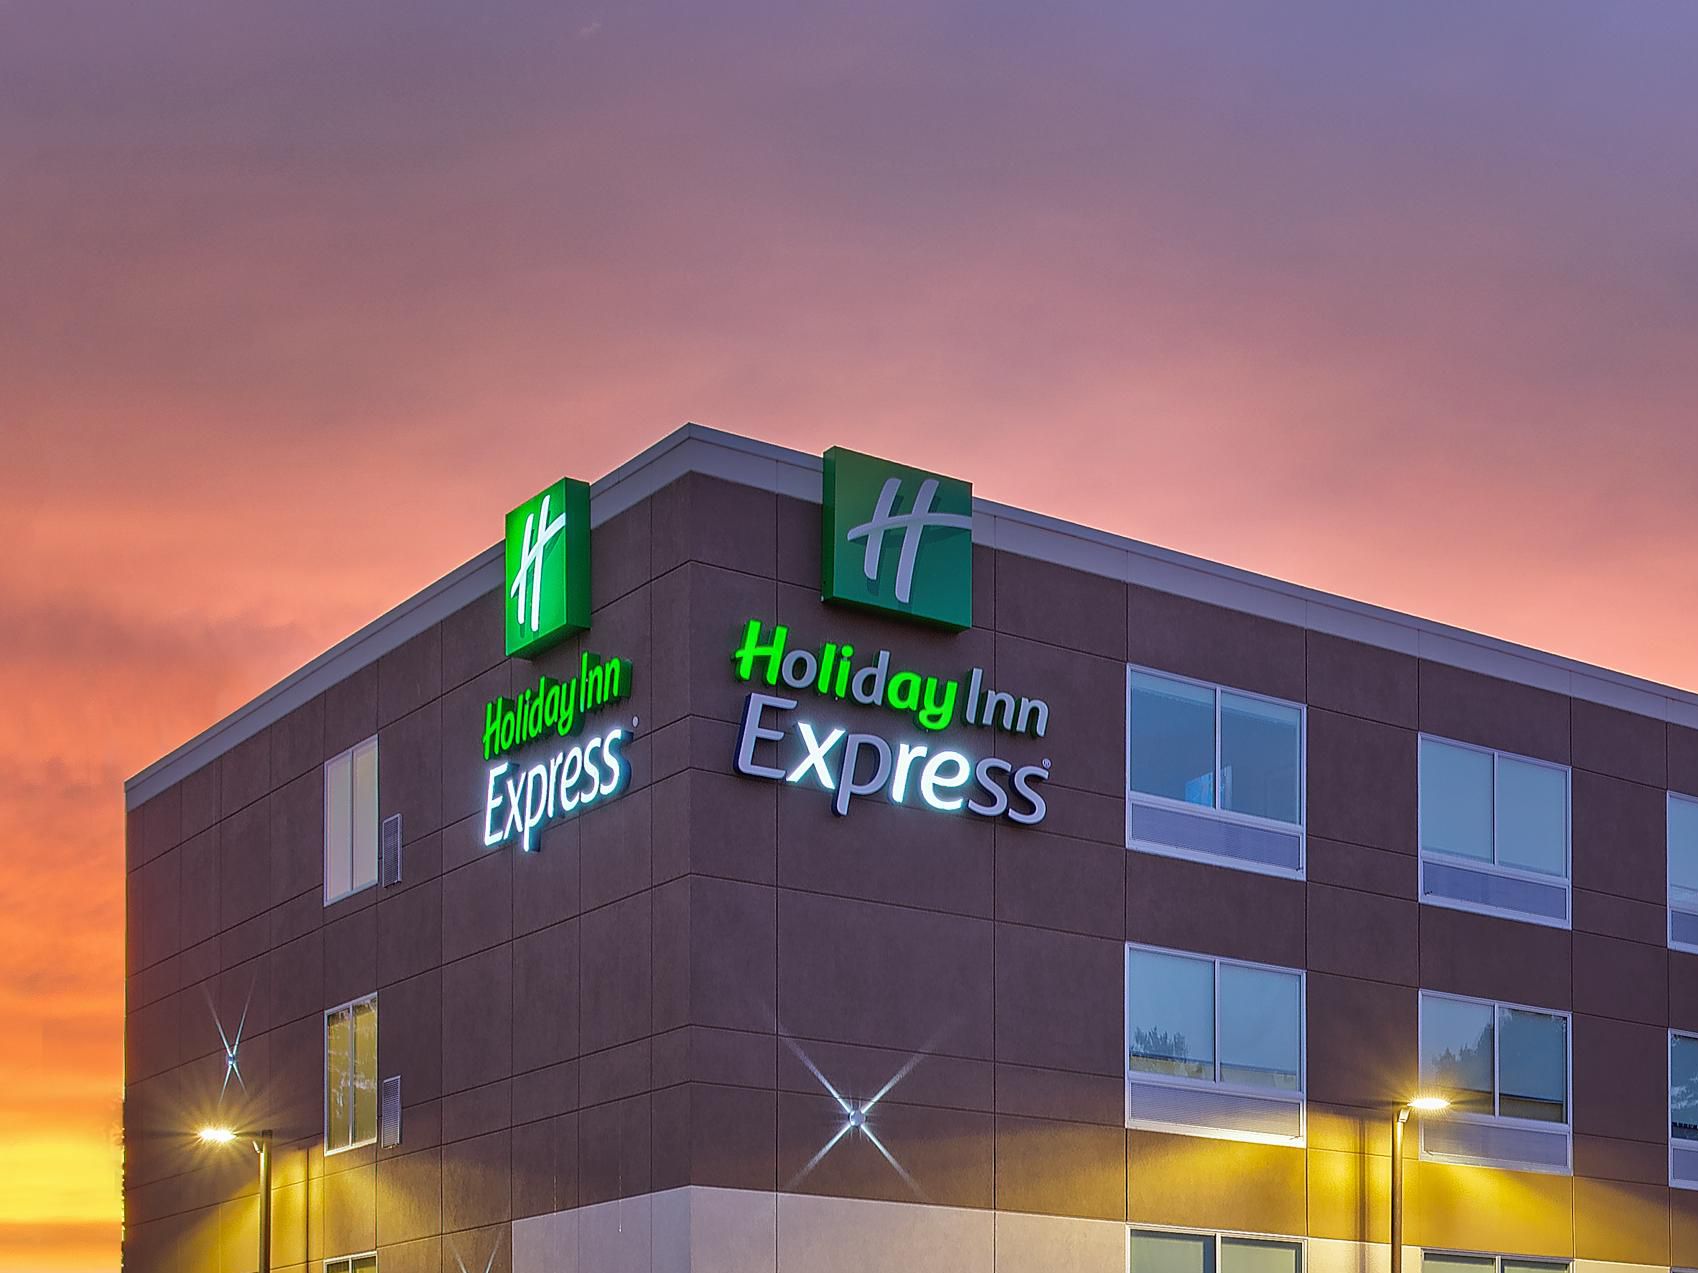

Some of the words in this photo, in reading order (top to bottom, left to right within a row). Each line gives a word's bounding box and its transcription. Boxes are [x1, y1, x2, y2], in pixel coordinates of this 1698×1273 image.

[482, 676, 577, 760] Holiday
[579, 651, 624, 713] Inn
[735, 619, 959, 731] Holiday
[964, 668, 1050, 737] Inn
[484, 728, 625, 852] Express
